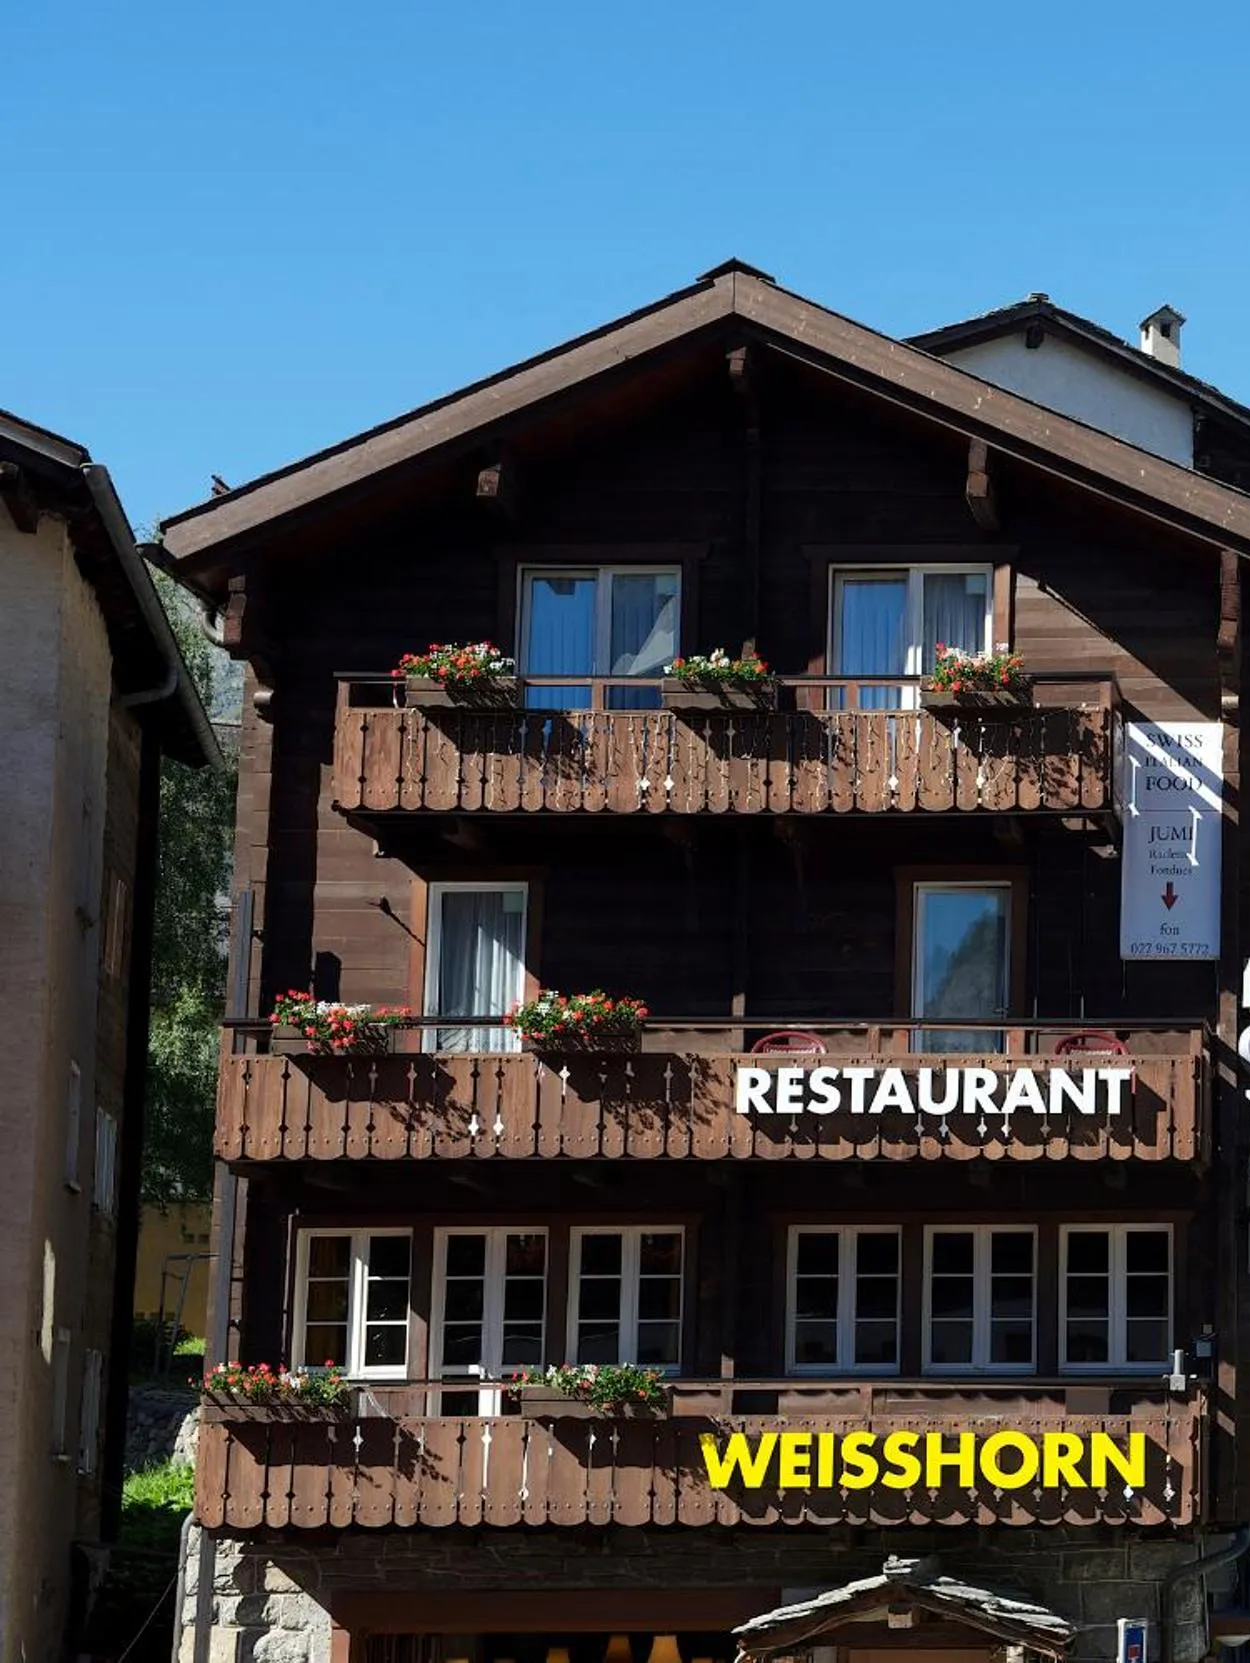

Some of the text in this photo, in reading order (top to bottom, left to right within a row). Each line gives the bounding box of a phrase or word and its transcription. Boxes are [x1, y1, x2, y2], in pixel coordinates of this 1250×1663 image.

[1146, 733, 1203, 748] SWISS
[1144, 757, 1203, 768] ITALIAN
[1146, 776, 1203, 792] FOOD
[1159, 922, 1180, 936] fon
[735, 1066, 1134, 1115] RESTAURANT
[699, 1431, 1146, 1490] WEISSHORN
